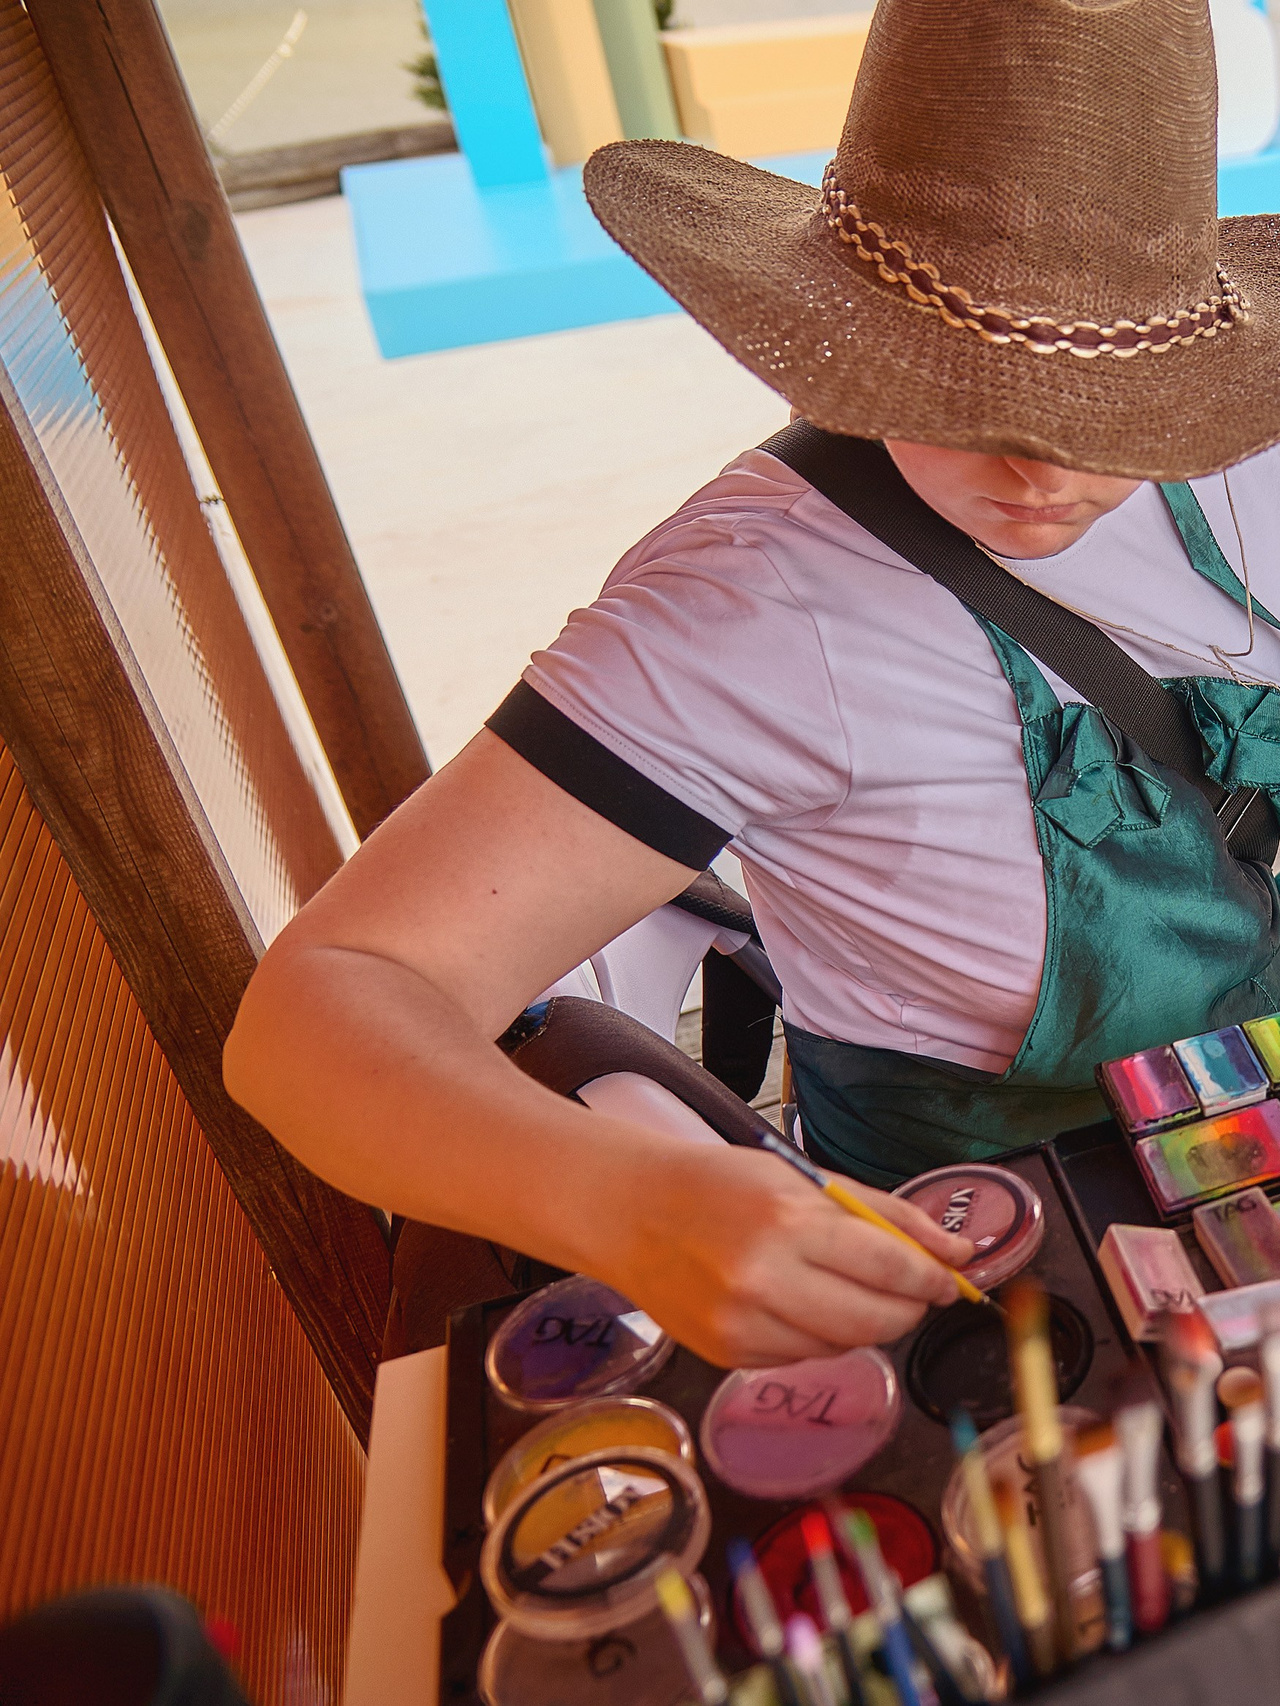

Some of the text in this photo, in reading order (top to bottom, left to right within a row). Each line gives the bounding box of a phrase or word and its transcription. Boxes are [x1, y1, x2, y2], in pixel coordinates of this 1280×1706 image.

[940, 1187, 976, 1233] SION
[1207, 1194, 1257, 1223] TAG
[533, 1315, 614, 1347] TAG
[752, 1381, 838, 1427] TAG
